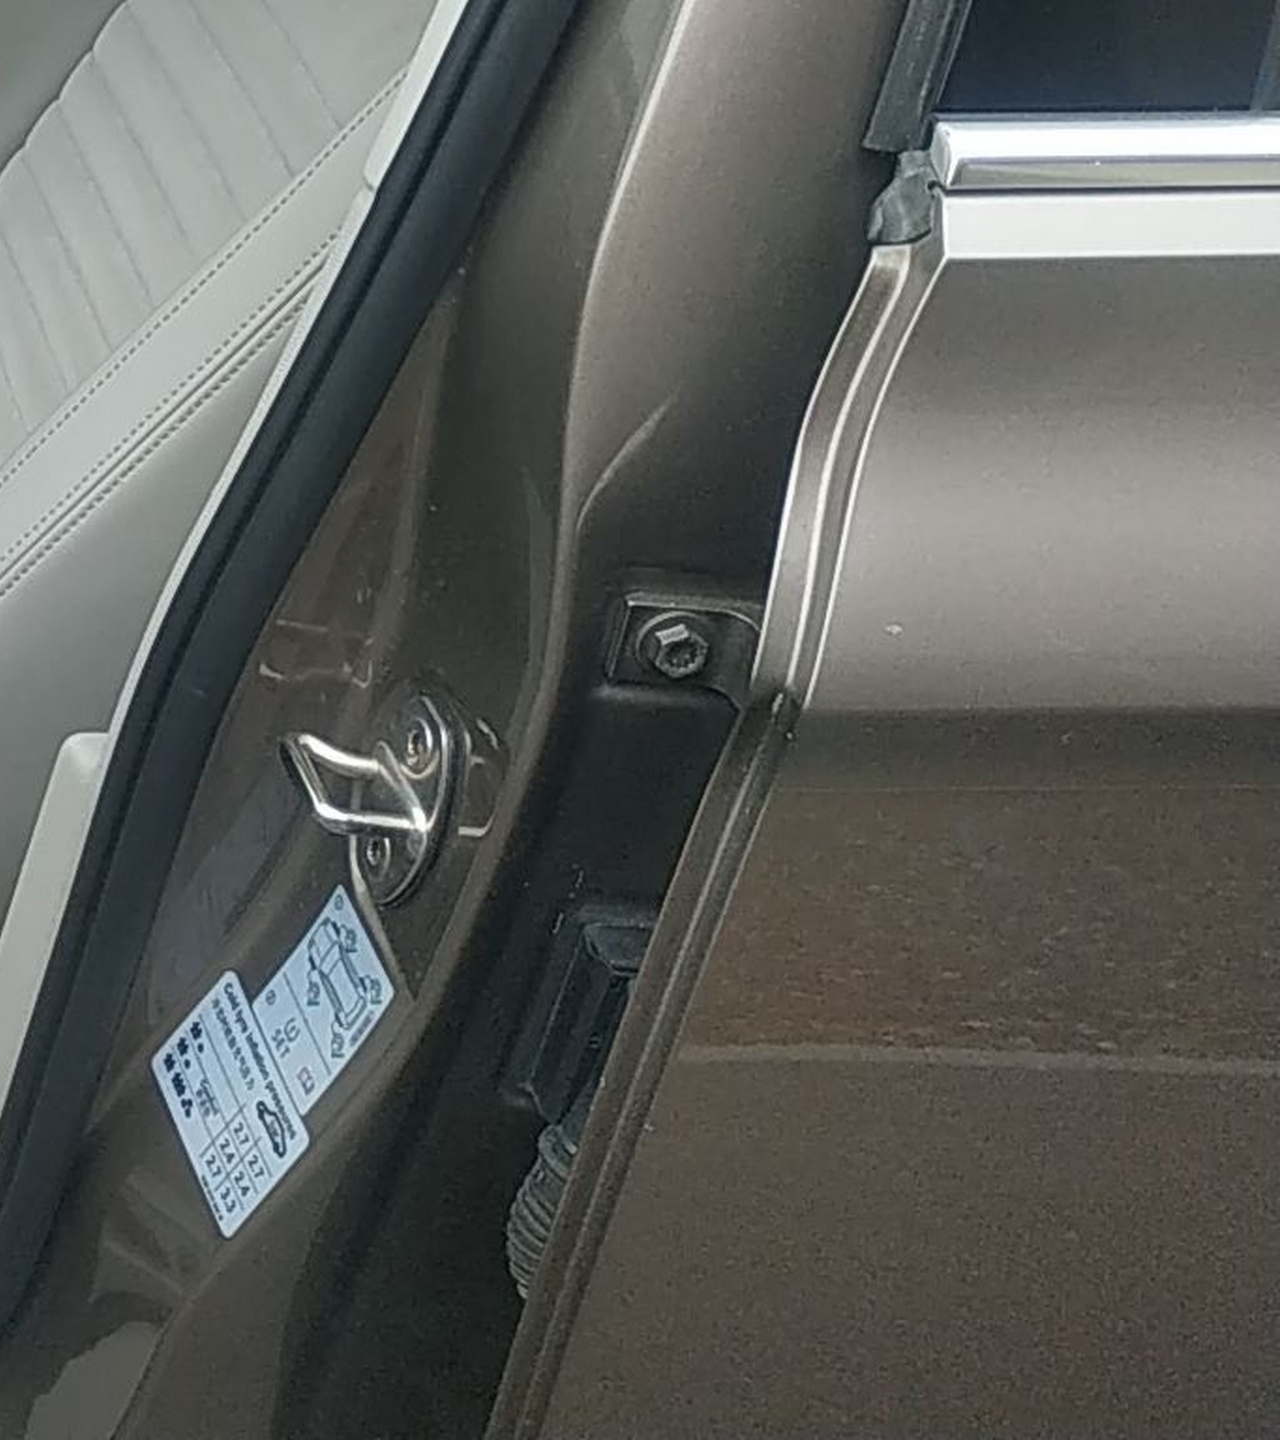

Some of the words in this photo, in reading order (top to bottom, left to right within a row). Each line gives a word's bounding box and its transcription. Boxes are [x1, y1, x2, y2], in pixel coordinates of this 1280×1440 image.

[223, 981, 240, 1010] Cold
[233, 1008, 249, 1035] tyre
[244, 1031, 271, 1080] inflation
[265, 1078, 297, 1140] pressures
[271, 1027, 289, 1061] SET
[205, 1152, 221, 1181] 2.7
[233, 1120, 250, 1149] 2.7
[247, 1152, 264, 1182] 2.7
